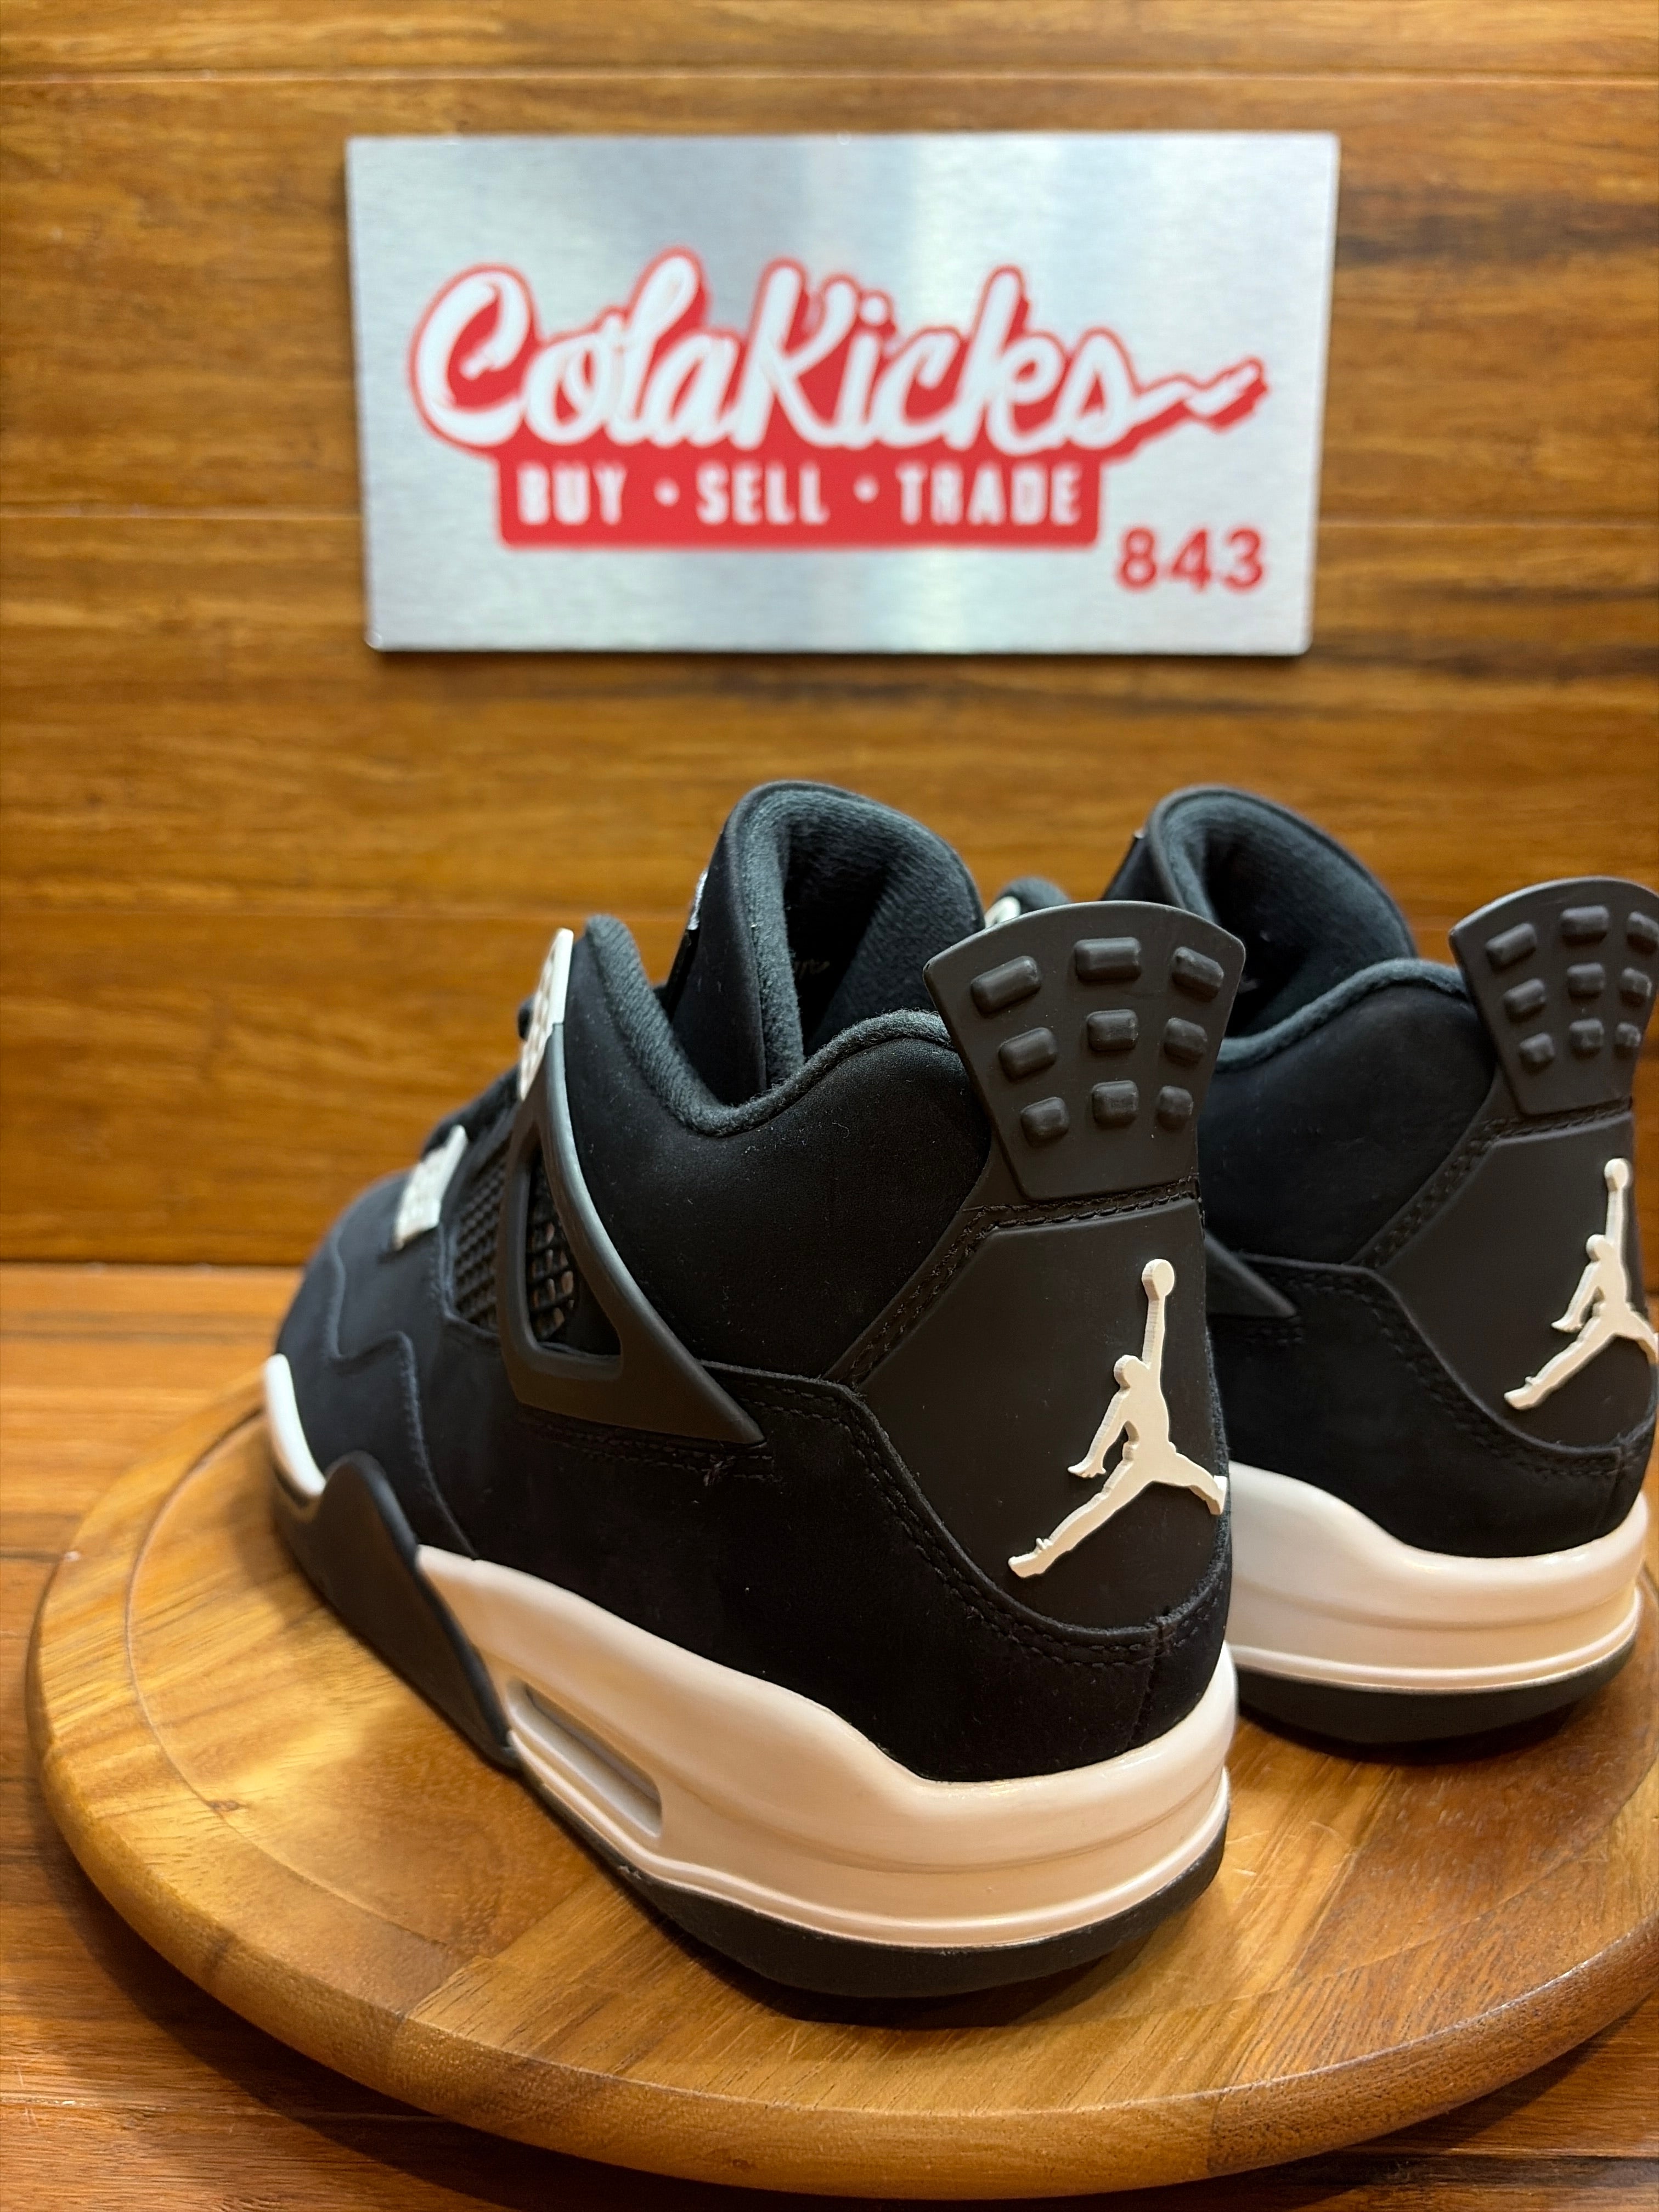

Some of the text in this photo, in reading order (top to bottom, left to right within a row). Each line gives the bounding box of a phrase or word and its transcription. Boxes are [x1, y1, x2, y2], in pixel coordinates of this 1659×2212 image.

[411, 250, 1267, 456] ColaKicks
[517, 464, 1080, 525] BUY SELL TRADE
[1117, 527, 1265, 591] 843
